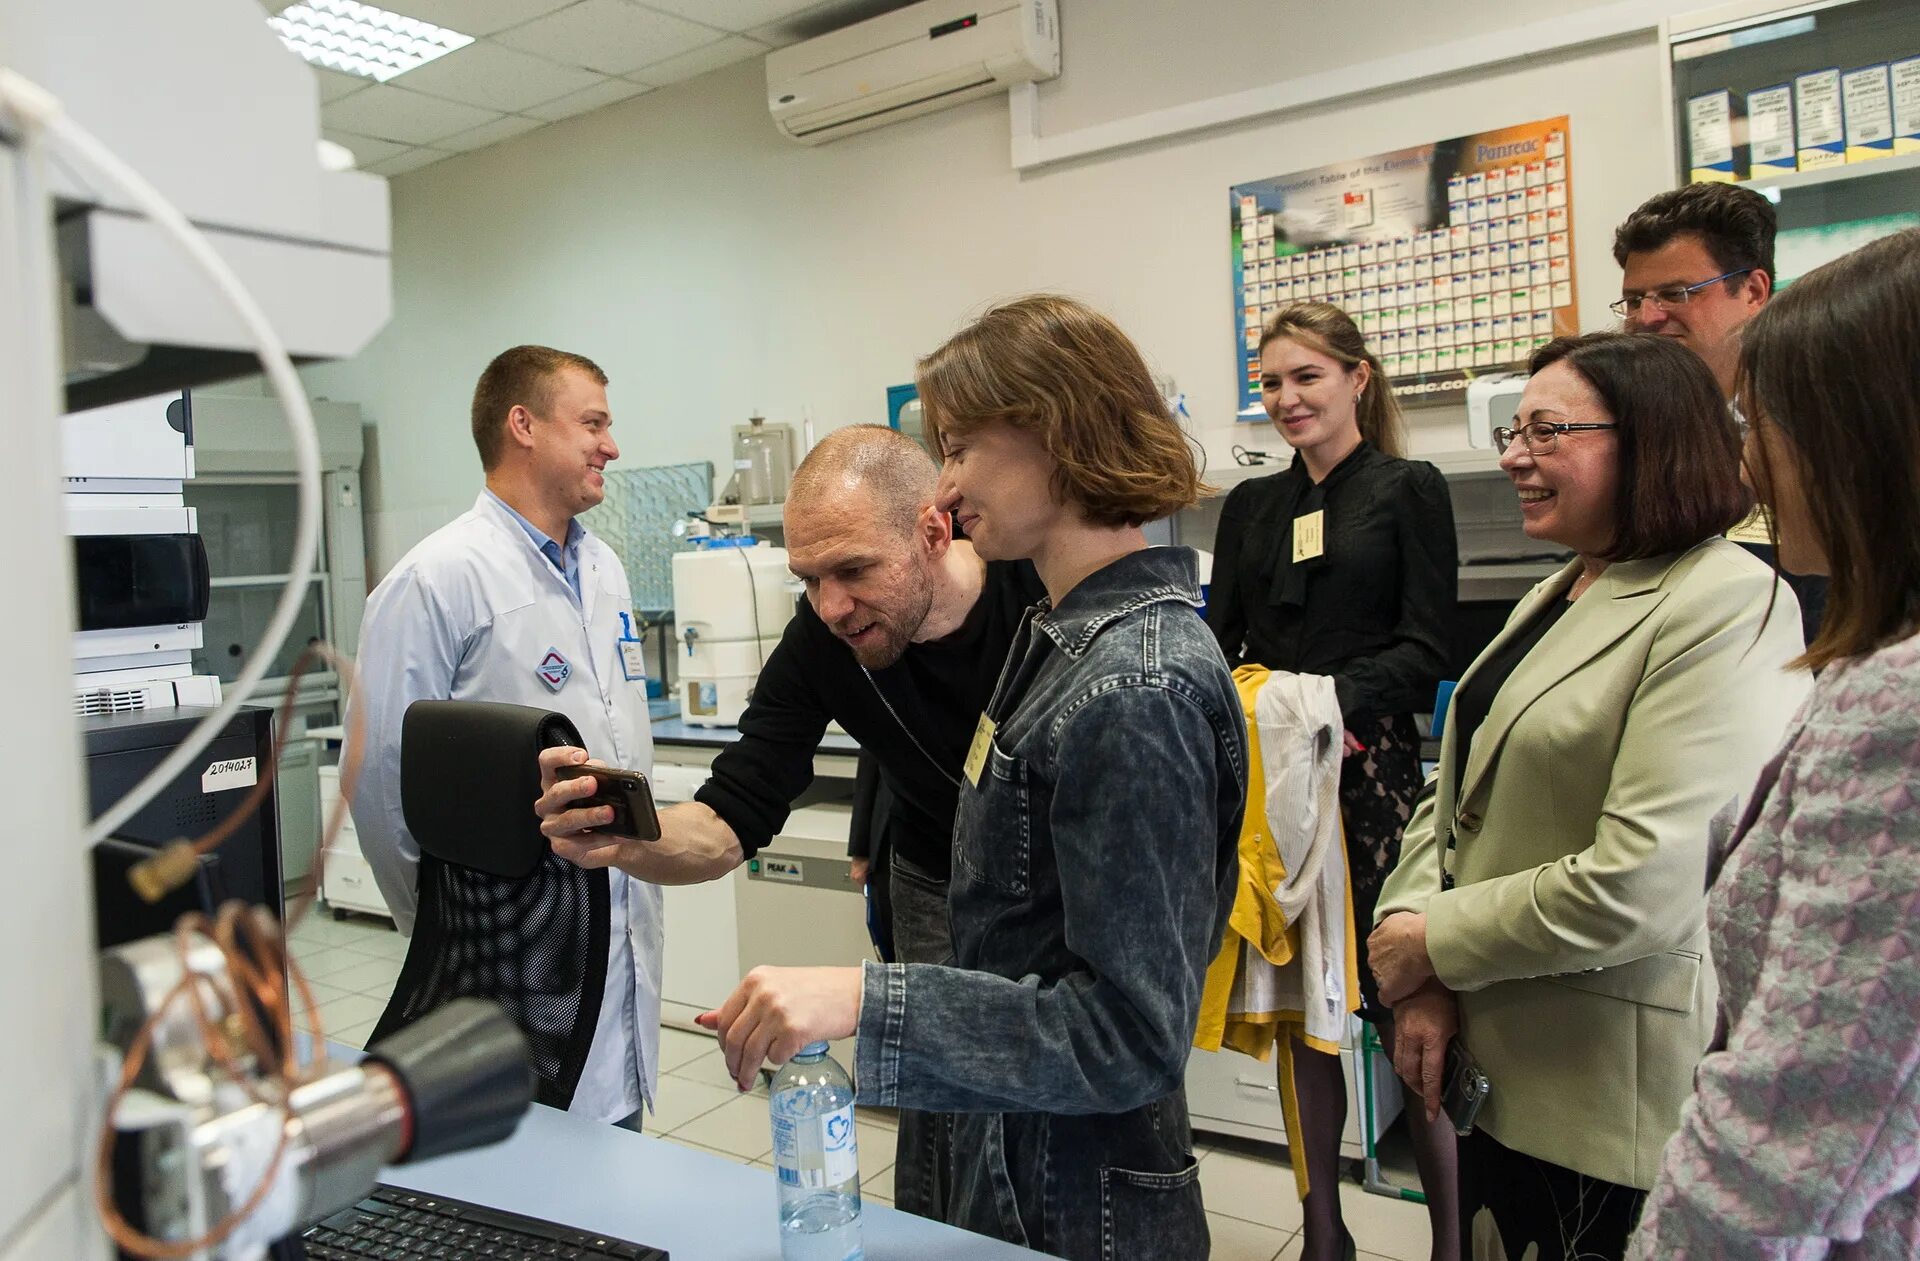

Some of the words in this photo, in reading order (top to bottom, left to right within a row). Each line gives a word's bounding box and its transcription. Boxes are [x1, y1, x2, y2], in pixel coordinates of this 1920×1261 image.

[1477, 139, 1538, 162] Panreac
[1320, 172, 1346, 184] Table
[1350, 168, 1361, 178] of
[1363, 164, 1381, 175] the
[210, 759, 252, 775] 2014027
[767, 863, 786, 873] PEAK
